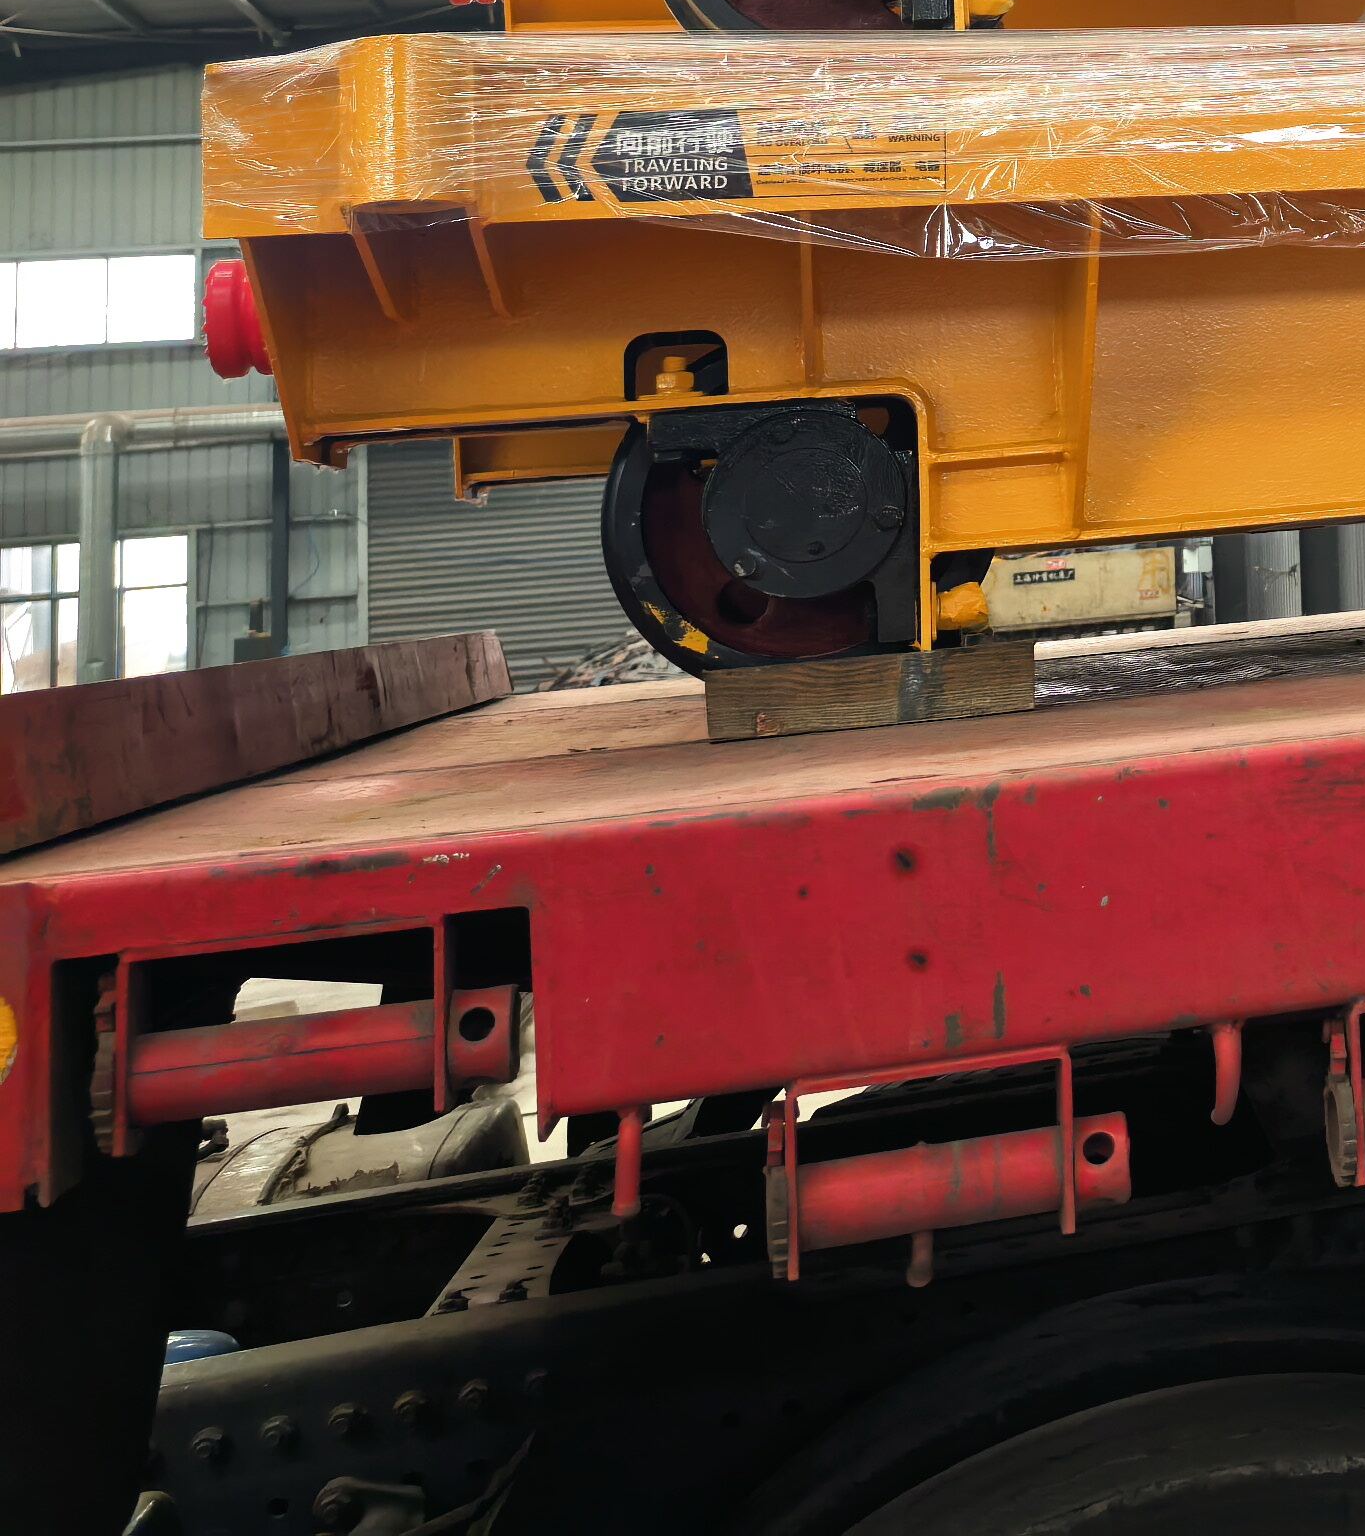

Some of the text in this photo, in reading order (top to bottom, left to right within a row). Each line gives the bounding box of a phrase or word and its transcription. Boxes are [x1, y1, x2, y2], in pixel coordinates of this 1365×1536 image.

[888, 133, 941, 144] WARNING
[624, 156, 728, 173] TRAVELING
[622, 175, 728, 192] FORWARD
